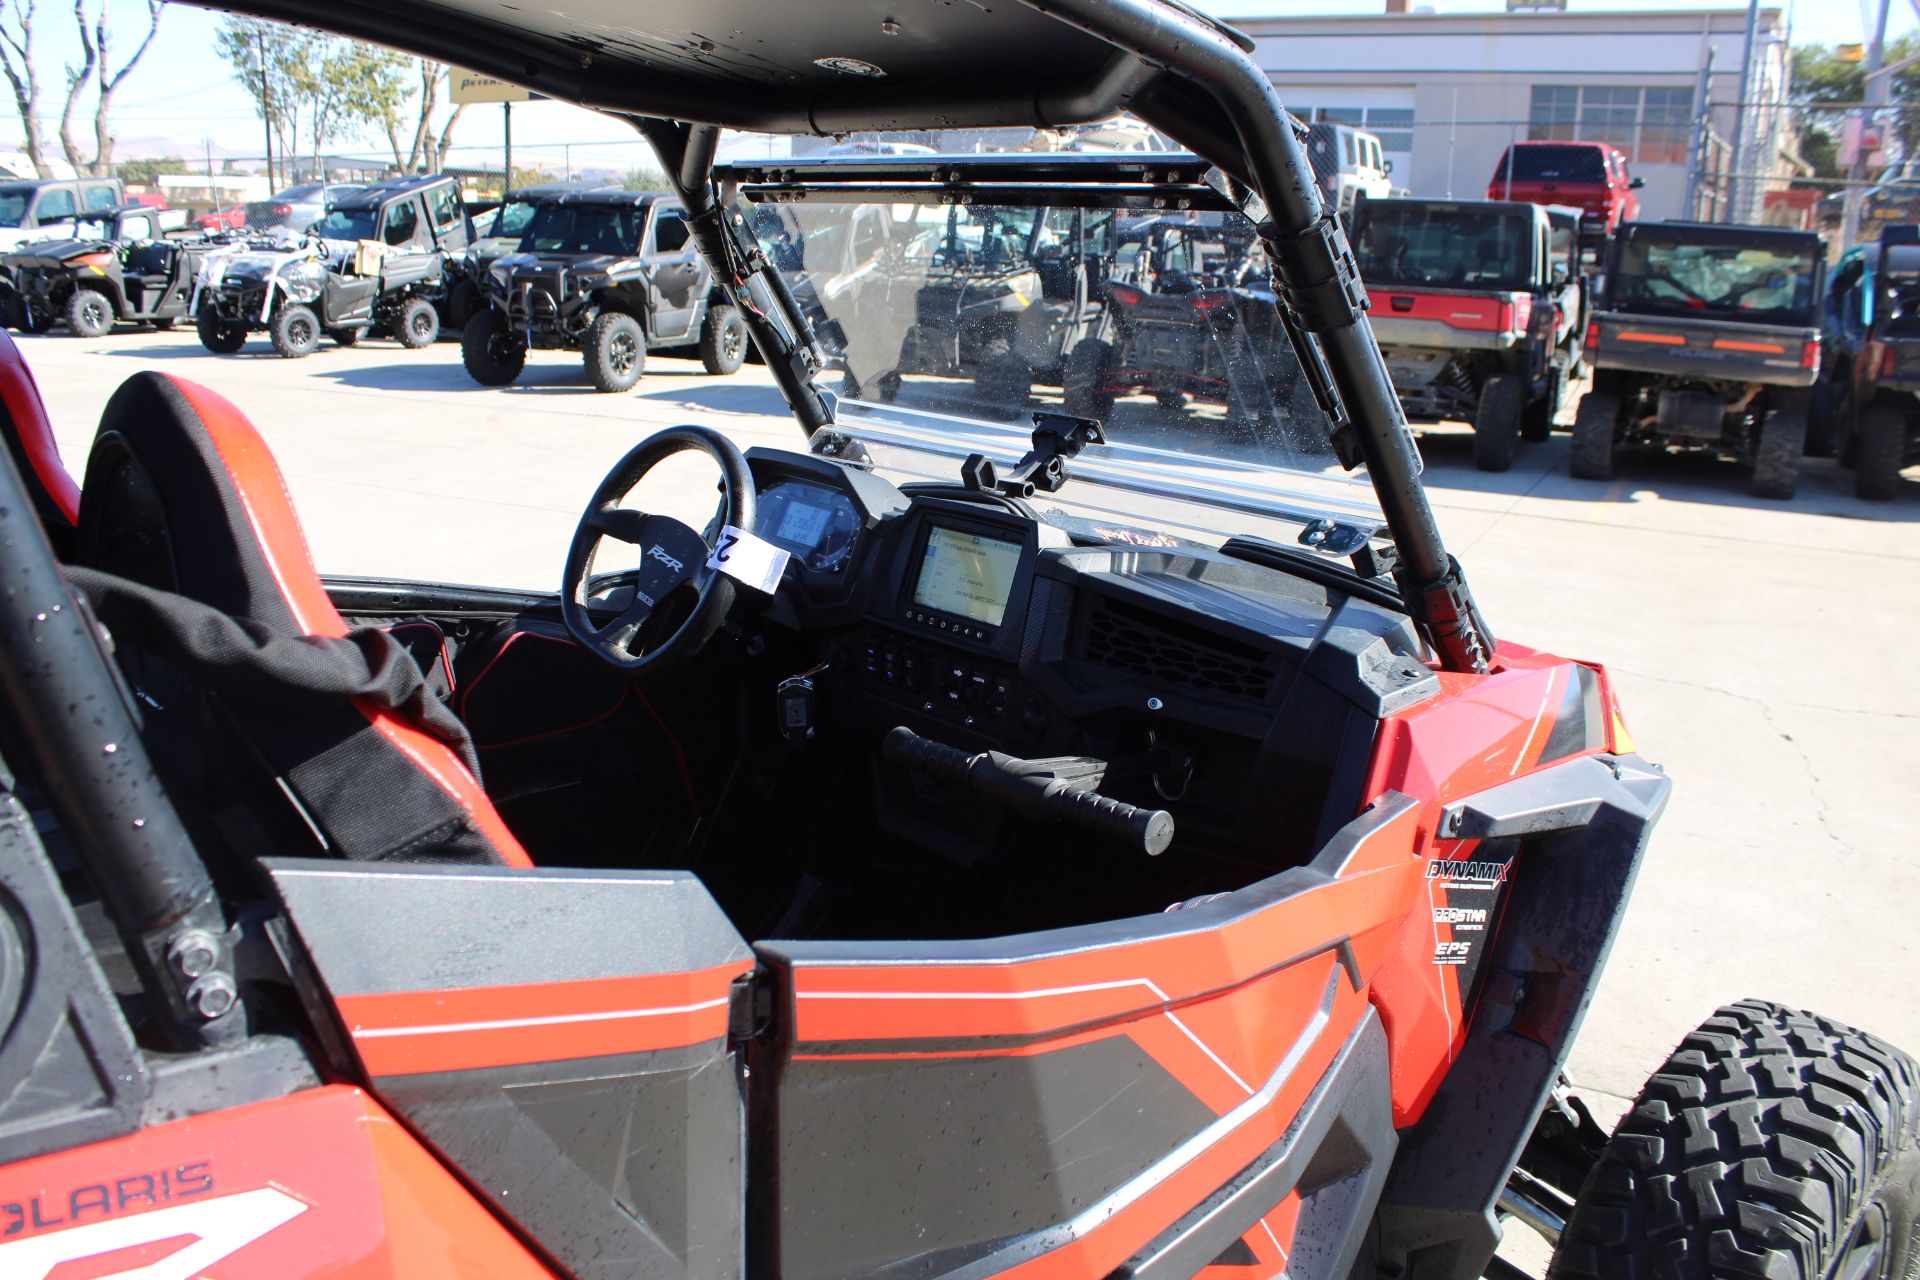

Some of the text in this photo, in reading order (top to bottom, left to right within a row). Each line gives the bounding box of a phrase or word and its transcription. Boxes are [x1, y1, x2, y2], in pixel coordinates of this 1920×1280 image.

[461, 79, 502, 90] PETER
[646, 546, 684, 573] RZR
[1425, 856, 1513, 882] DYNAMIX
[1433, 908, 1487, 923] PROSTAR
[1434, 942, 1471, 955] EPS
